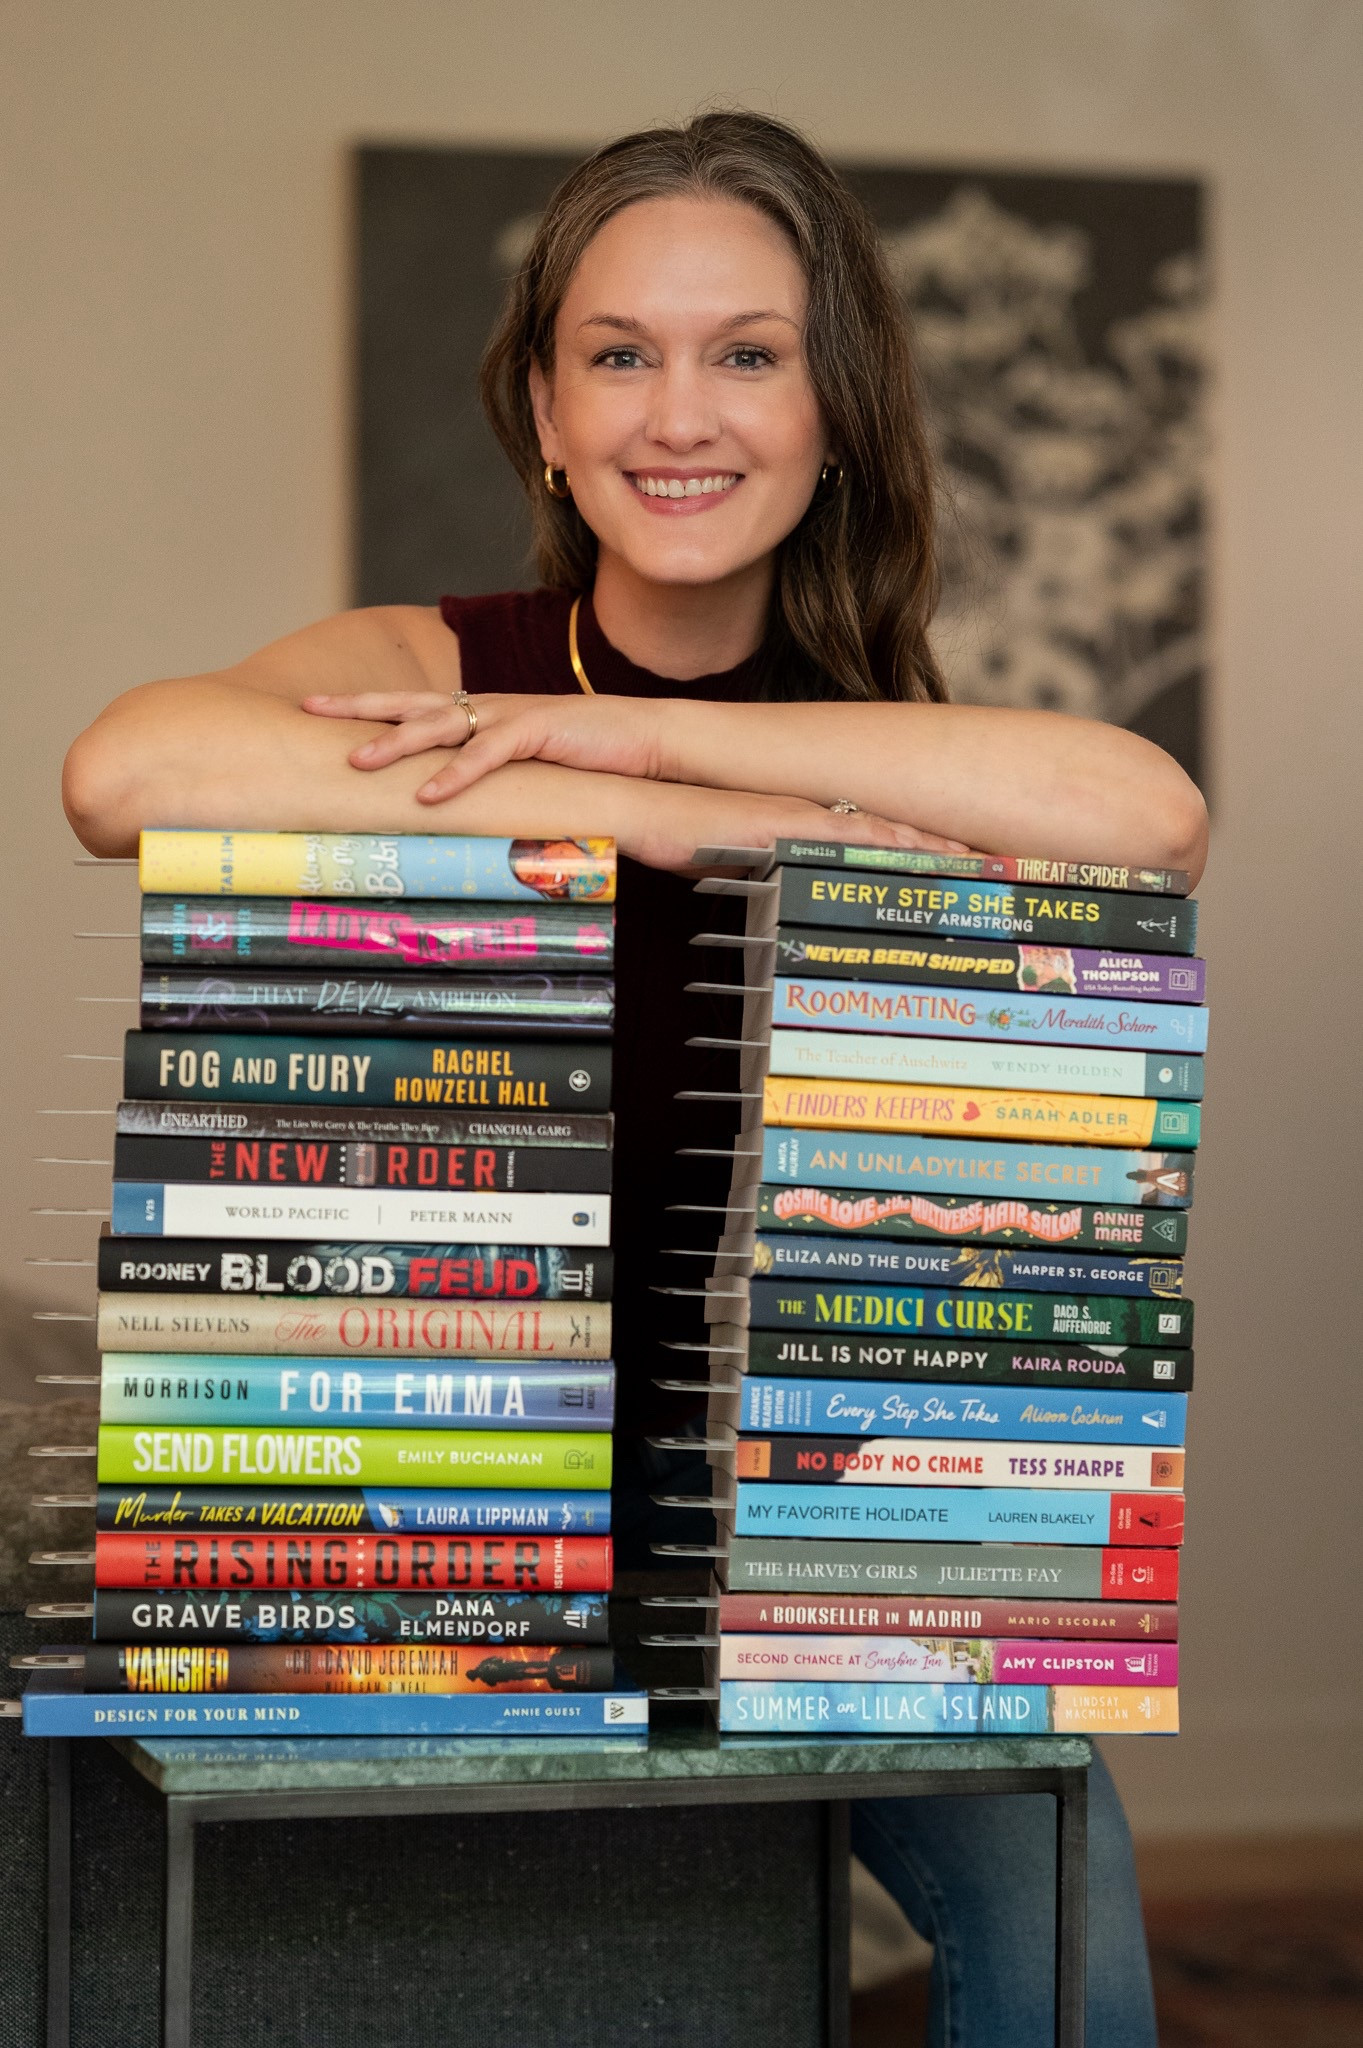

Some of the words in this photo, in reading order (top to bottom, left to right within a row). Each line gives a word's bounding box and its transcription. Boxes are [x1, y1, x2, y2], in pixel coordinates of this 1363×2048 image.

[220, 834, 233, 894] TASLIM
[296, 834, 326, 892] Always
[332, 837, 361, 867] My
[790, 844, 837, 858] Spradlin
[365, 840, 404, 896] Bibi
[1016, 858, 1068, 883] THREAT
[1079, 865, 1130, 888] SPIDER
[333, 874, 355, 894] Be
[811, 880, 889, 905] EVERY
[898, 888, 959, 910] STEP
[968, 893, 1015, 915] SHE
[1025, 898, 1100, 922] TAKES
[300, 908, 400, 949] LADY'S
[416, 924, 521, 957] KNIGHT
[804, 944, 870, 964] NEVER
[872, 948, 928, 968] BEEN
[927, 952, 1016, 975] SHIPPED
[1098, 957, 1144, 969] ALICIA
[1082, 970, 1160, 982] THOMPSON
[248, 986, 309, 1005] THAT
[412, 990, 517, 1008] AMBITION
[787, 984, 977, 1027] ROOMMATING
[1032, 1008, 1105, 1030] Meredith
[1106, 1012, 1158, 1035] Schorr
[159, 1049, 221, 1089] FOG
[232, 1057, 277, 1084] AND
[287, 1053, 371, 1093] FURY
[432, 1049, 514, 1077] RACHEL
[794, 1047, 821, 1061] The
[826, 1049, 876, 1065] Teacher
[880, 1052, 896, 1066] of
[898, 1054, 968, 1071] Auschwitz
[991, 1060, 1051, 1074] WENDY
[1057, 1063, 1124, 1078] HOLDEN
[394, 1077, 490, 1105] HOWZELL
[498, 1080, 550, 1107] HALL
[785, 1092, 868, 1119] FINDERS
[874, 1096, 955, 1122] KEEPERS
[160, 1112, 249, 1129] UNEARTHED
[276, 1119, 291, 1129] The
[293, 1120, 309, 1129] Lies
[310, 1120, 323, 1130] We
[324, 1120, 346, 1132] Carry
[347, 1121, 355, 1130] &
[357, 1121, 372, 1131] The
[373, 1121, 400, 1132] Truths
[400, 1123, 420, 1134] They
[421, 1123, 440, 1135] Bury
[209, 1141, 227, 1179] THE
[235, 1141, 329, 1182] NEW
[789, 1138, 799, 1178] MURRAY
[809, 1149, 848, 1170] AN
[858, 1151, 1006, 1181] UNLADYLIKE
[1016, 1162, 1103, 1185] SECRET
[225, 1206, 283, 1220] WORLD
[288, 1207, 350, 1221] PACIFIC
[773, 1187, 830, 1217] COSMIC
[829, 1196, 878, 1226] LOVE
[910, 1195, 983, 1231] MULTIVERSE
[982, 1200, 1029, 1235] HAIR
[1029, 1206, 1083, 1239] SALON
[1166, 1218, 1175, 1241] ACE
[775, 1248, 821, 1264] ELIZA
[825, 1252, 863, 1267] AND
[868, 1254, 900, 1269] THE
[905, 1256, 950, 1272] DUKE
[220, 1253, 396, 1295] BLOOD
[408, 1258, 539, 1296] FEUD
[584, 1263, 594, 1298] ARCADE
[118, 1315, 164, 1332] NELL
[171, 1316, 250, 1334] STEVENS
[777, 1299, 806, 1315] THE
[815, 1293, 924, 1327] MEDICI
[936, 1298, 1033, 1332] CURSE
[1053, 1304, 1079, 1319] DACO
[1082, 1306, 1091, 1319] S.
[274, 1310, 327, 1342] The
[338, 1306, 555, 1351] ORIGINAL
[1053, 1319, 1112, 1335] AUFFENORDE
[777, 1343, 823, 1362] JILL
[831, 1345, 850, 1363] IS
[859, 1347, 906, 1366] NOT
[913, 1349, 988, 1369] HAPPY
[124, 1377, 249, 1400] MORRISON
[280, 1370, 363, 1413] FOR
[395, 1372, 525, 1417] EMMA
[750, 1386, 761, 1427] ADVANCE
[762, 1385, 773, 1428] READER'S
[774, 1390, 785, 1425] EDITION
[826, 1393, 877, 1431] Every
[882, 1394, 919, 1429] Step
[922, 1397, 957, 1423] She
[959, 1399, 1000, 1424] Takes
[1019, 1405, 1069, 1424] Alison
[1070, 1405, 1123, 1425] Cochrun
[133, 1431, 214, 1473] SEND
[222, 1433, 362, 1476] FLOWERS
[796, 1451, 827, 1470] NO
[833, 1452, 885, 1472] BODY
[892, 1455, 921, 1472] NO
[928, 1455, 983, 1474] CRIME
[1009, 1457, 1047, 1475] TESS
[1054, 1458, 1124, 1478] SHARPE
[114, 1491, 194, 1527] Murder
[199, 1505, 244, 1522] TAKES
[245, 1506, 256, 1522] A
[260, 1502, 365, 1526] VACATION
[748, 1505, 773, 1519] MY
[777, 1505, 861, 1521] FAVORITE
[866, 1507, 949, 1523] HOLIDATE
[145, 1541, 161, 1582] THE
[173, 1539, 348, 1585] RISING
[374, 1540, 540, 1586] ORDER
[554, 1538, 564, 1589] ISENTHAL
[745, 1562, 783, 1577] THE
[788, 1563, 862, 1579] HARVEY
[866, 1565, 918, 1580] GIRLS
[938, 1566, 1026, 1584] JULIETTE
[1027, 1568, 1063, 1583] FAY
[132, 1604, 242, 1629] GRAVE
[258, 1604, 357, 1630] BIRDS
[760, 1609, 767, 1622] A
[773, 1606, 879, 1627] BOOKSELLER
[886, 1611, 899, 1625] IN
[908, 1609, 982, 1629] MADRID
[125, 1647, 230, 1693] VANISHED
[325, 1650, 372, 1675] DAVID
[379, 1650, 458, 1676] JEREMIAH
[737, 1653, 789, 1665] SECOND
[794, 1654, 843, 1666] CHANCE
[848, 1654, 862, 1666] AT
[864, 1650, 918, 1671] Sunshine
[921, 1654, 944, 1671] Inn
[1002, 1657, 1037, 1670] AMY
[1042, 1658, 1115, 1671] CLIPSTON
[358, 1682, 381, 1693] SAM
[736, 1695, 830, 1721] SUMMER
[837, 1701, 858, 1715] on
[861, 1695, 927, 1721] LILAC
[942, 1695, 1031, 1721] ISLAND
[1065, 1708, 1129, 1720] MACMILLAN
[1073, 1696, 1119, 1707] LINDSAY
[94, 1708, 158, 1723] DESIGN
[164, 1708, 198, 1722] FOR
[203, 1708, 248, 1722] YOUR
[254, 1707, 301, 1721] MIND
